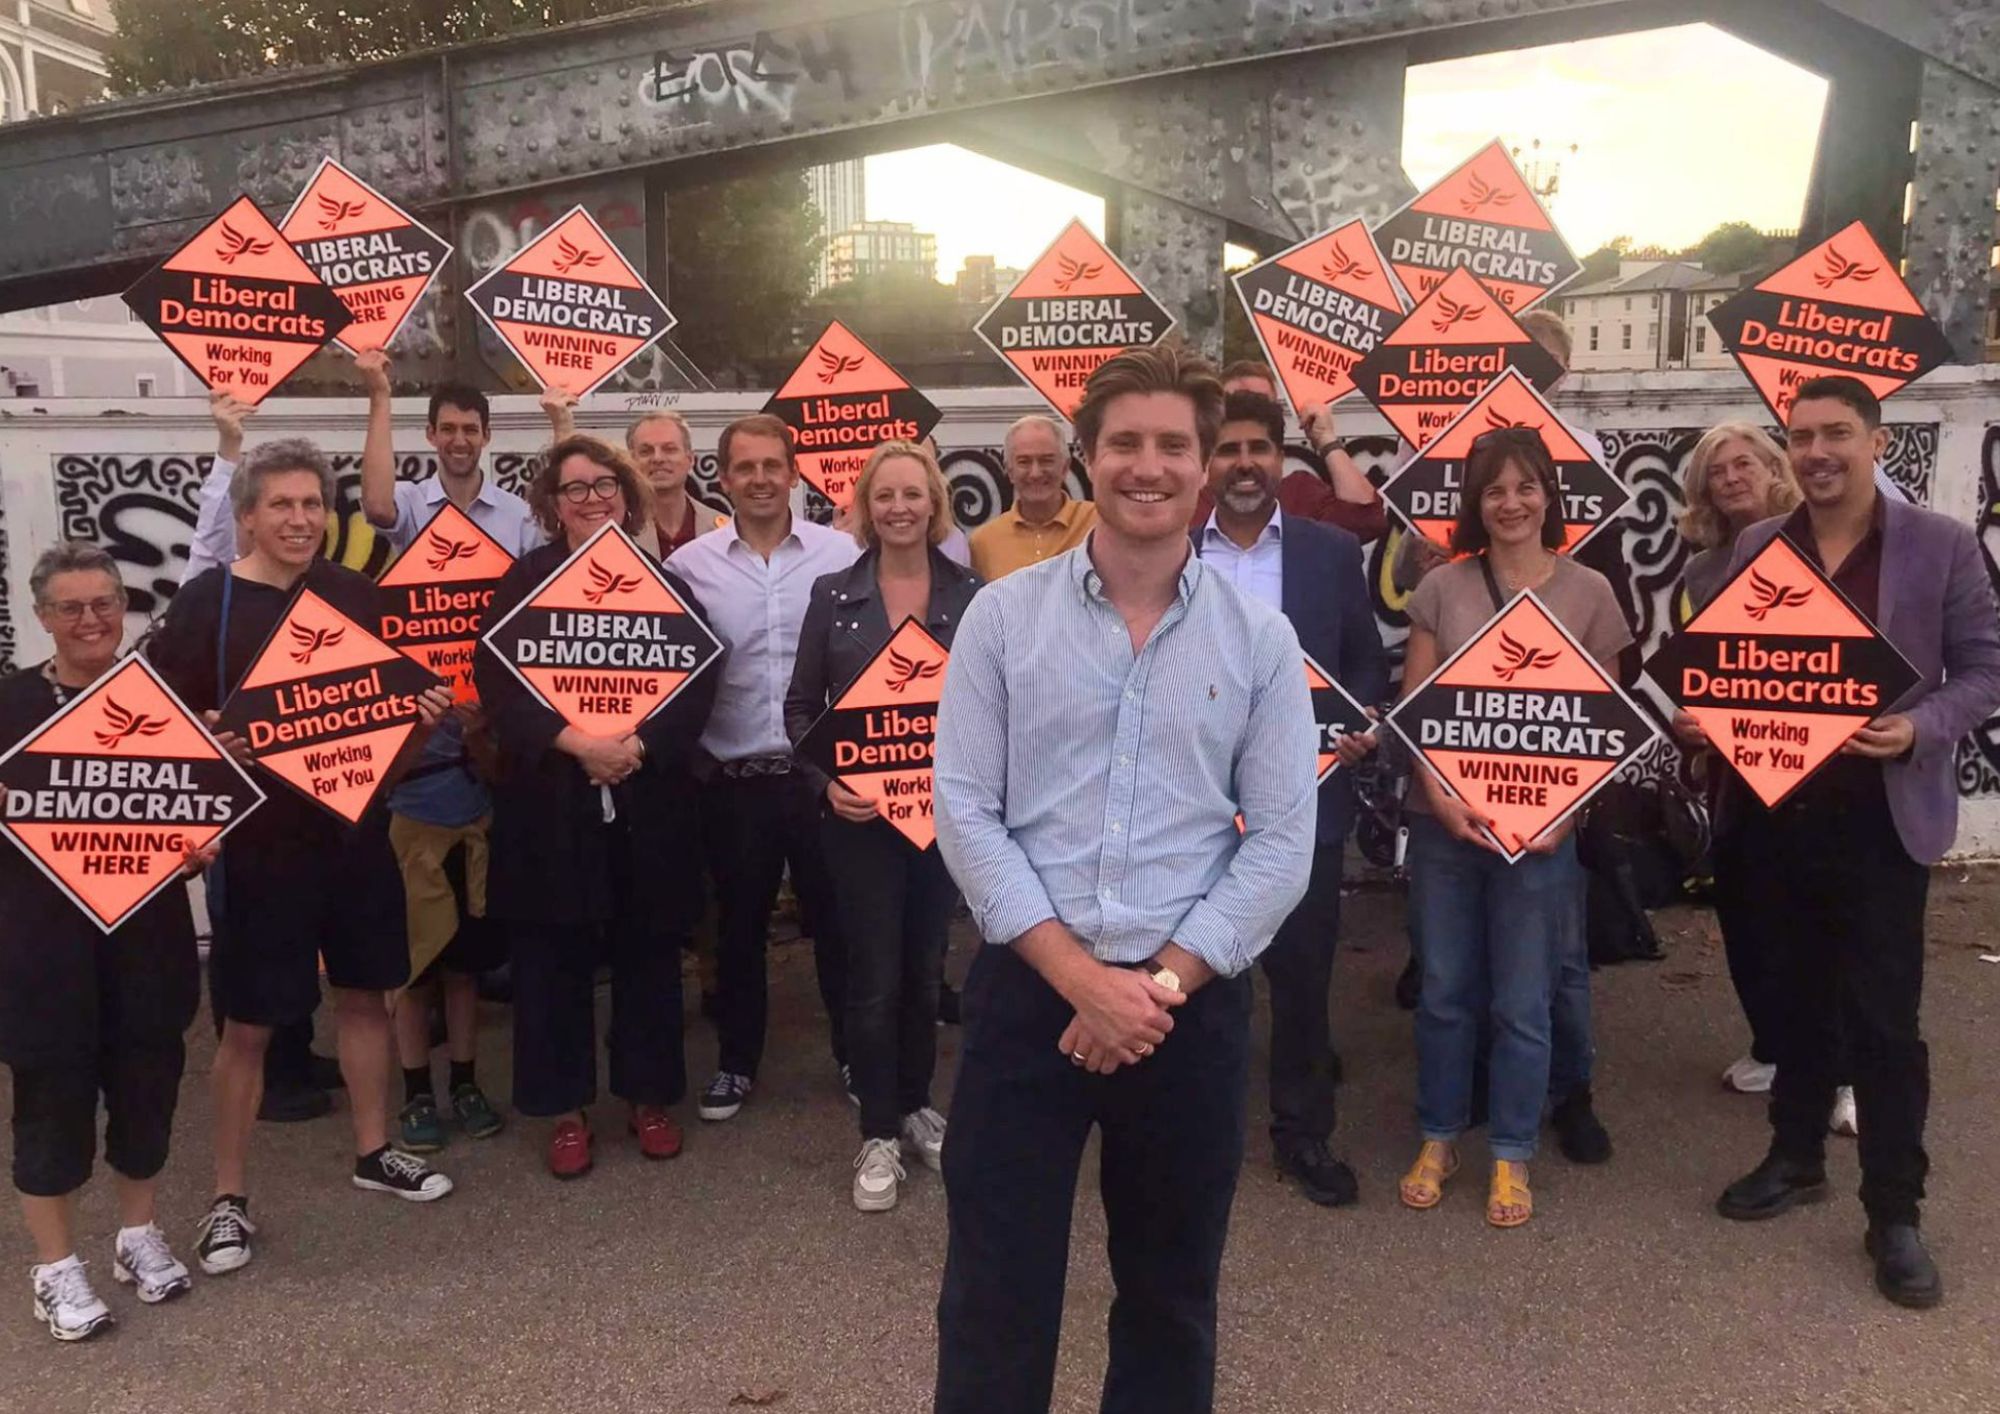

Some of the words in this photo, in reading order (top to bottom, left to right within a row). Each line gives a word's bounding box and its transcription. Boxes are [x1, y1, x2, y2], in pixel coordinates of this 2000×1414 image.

[296, 232, 402, 266] LIBERAL
[1423, 217, 1532, 256] LIBERAL
[1391, 238, 1557, 285] DEMOCRATS
[192, 278, 296, 312] Liberal
[521, 277, 628, 311] LIBERAL
[1284, 275, 1383, 332] LIBERAL
[160, 299, 326, 338] Democrats
[352, 305, 387, 325] ERE
[492, 296, 653, 337] DEMOCRATS
[1026, 299, 1128, 324] LIBERAL
[1253, 287, 1384, 353] DEMOCRA
[1778, 301, 1893, 342] Liberal
[523, 330, 617, 357] WINNING
[1001, 322, 1154, 348] DEMOCRATS
[1739, 320, 1920, 373] Democrats
[205, 343, 273, 366] Working
[545, 351, 594, 370] HERE
[1409, 347, 1505, 375] Liberal
[209, 365, 234, 386] For
[239, 368, 269, 387] You
[1291, 354, 1339, 387] HERE
[1379, 374, 1532, 398] Democr
[802, 394, 890, 424] Liberal
[824, 478, 846, 494] For
[381, 614, 481, 640] Democ
[549, 612, 668, 641] LIBERAL
[517, 638, 697, 668] DEMOCRATS
[1718, 640, 1840, 675] Liberal
[275, 668, 382, 717] Liberal
[553, 675, 659, 696] WINNING
[1682, 668, 1879, 707] Democrats
[579, 697, 633, 715] HERE
[1455, 690, 1591, 724] LIBERAL
[248, 693, 418, 750] Democrats
[865, 710, 938, 739] Liber
[1731, 717, 1809, 746] Working
[1420, 718, 1627, 757] DEMOCRATS
[304, 744, 373, 774] Working
[1733, 745, 1764, 767] For
[1768, 748, 1805, 770] You
[49, 758, 199, 790] LIBERAL
[312, 776, 339, 798] For
[342, 767, 375, 789] You
[883, 776, 932, 797] Worki
[1458, 759, 1579, 787] WINNING
[5, 789, 234, 822] DEMOCRATS
[1486, 784, 1548, 807] HERE
[887, 801, 914, 821] For
[50, 831, 183, 853] WINNING
[82, 854, 151, 875] HERE
